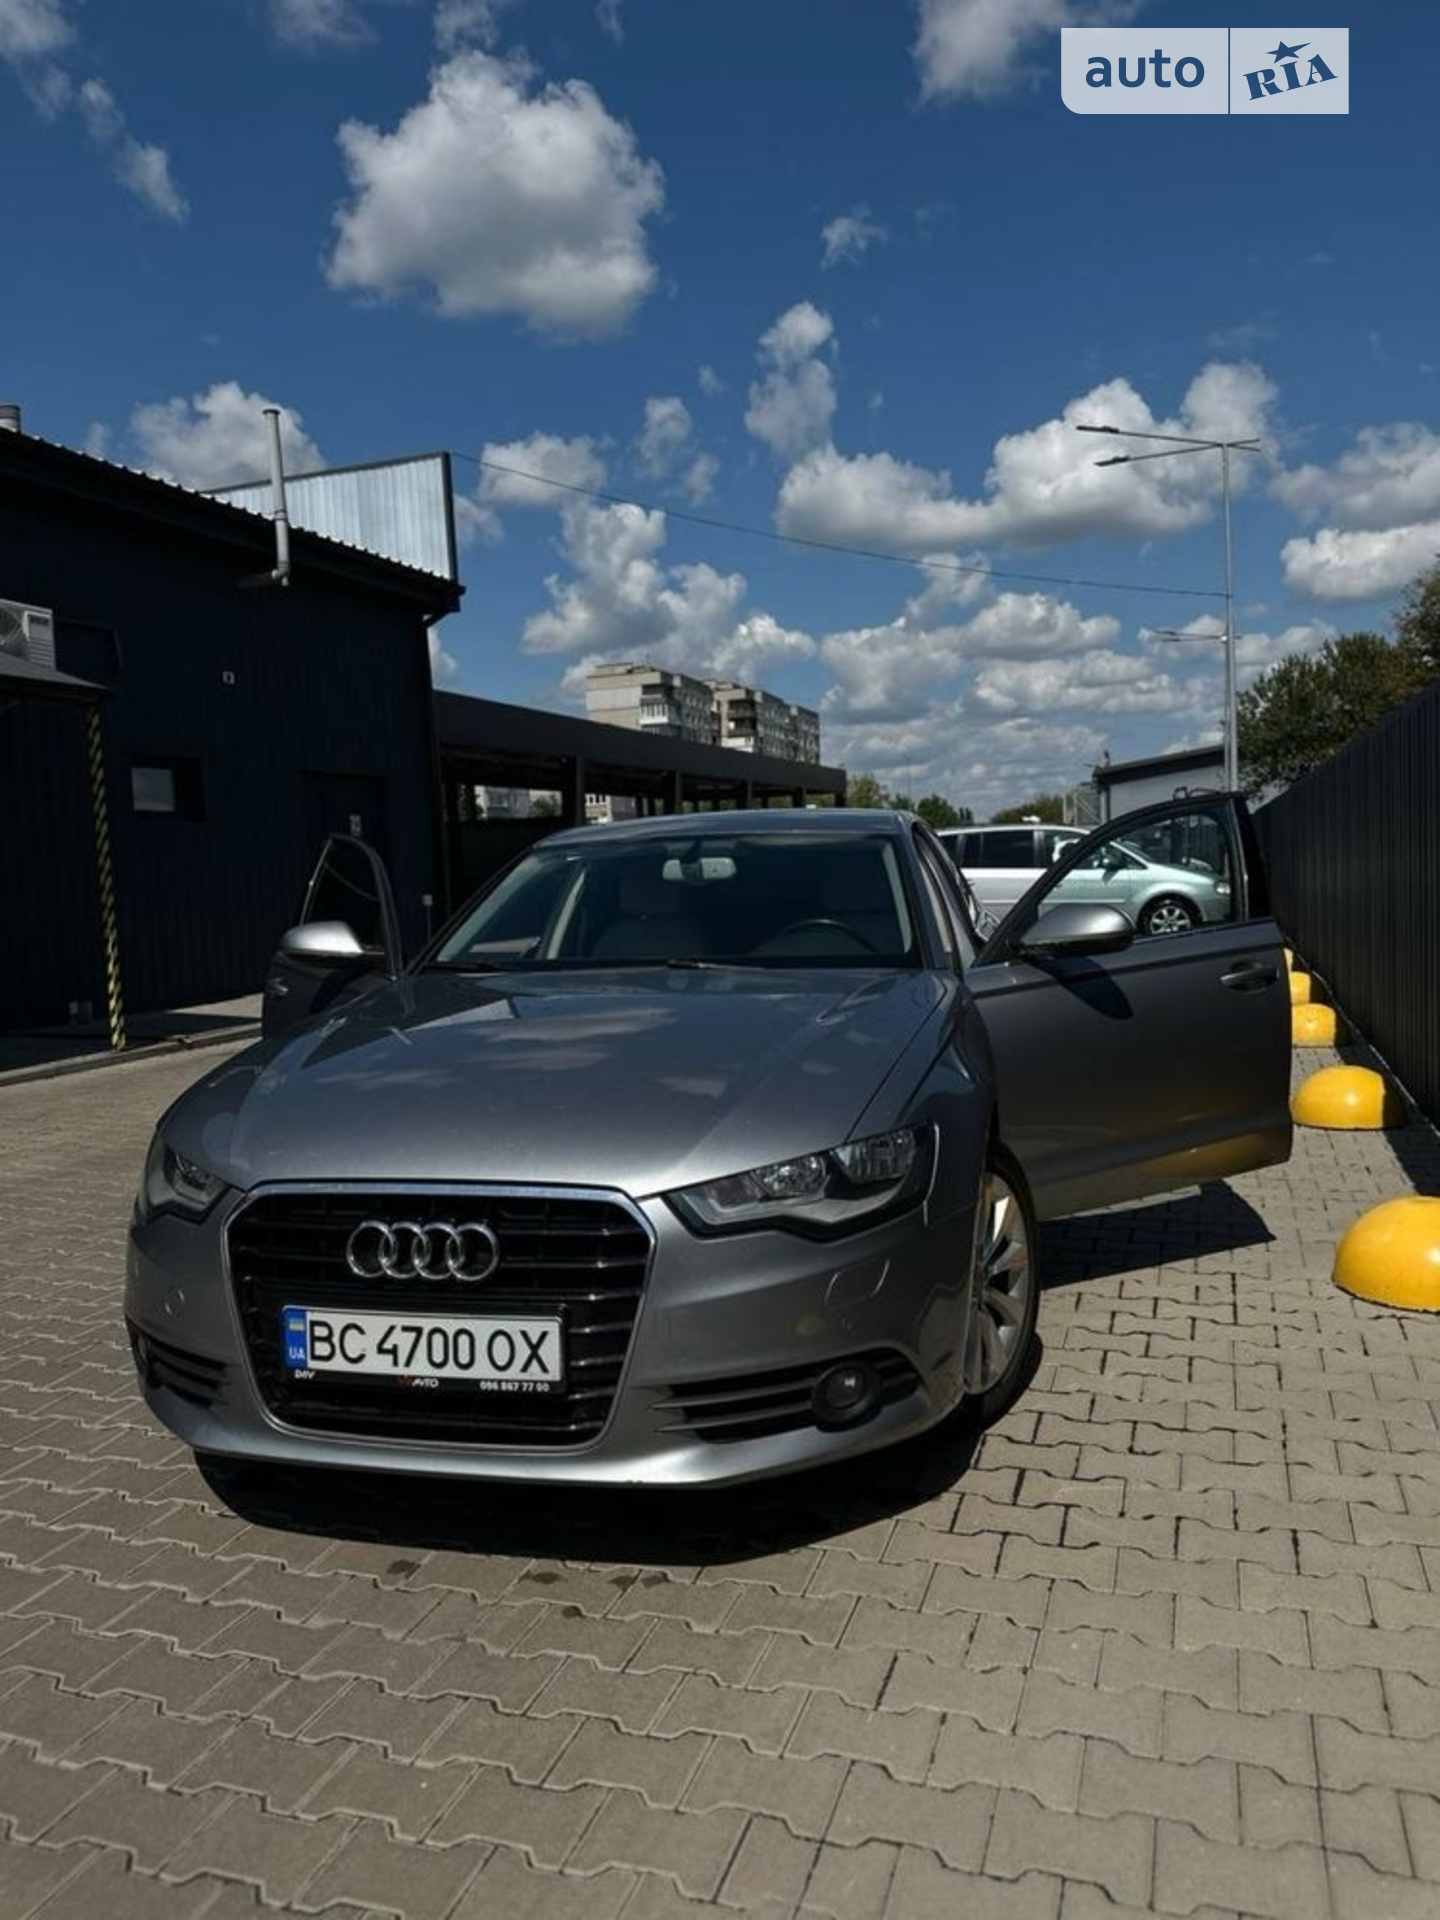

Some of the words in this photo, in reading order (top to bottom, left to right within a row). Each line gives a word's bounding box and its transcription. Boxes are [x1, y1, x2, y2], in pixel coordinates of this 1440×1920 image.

[289, 1347, 306, 1359] UA
[309, 1319, 367, 1364] BC
[376, 1325, 476, 1370] 4700
[487, 1329, 550, 1374] OX
